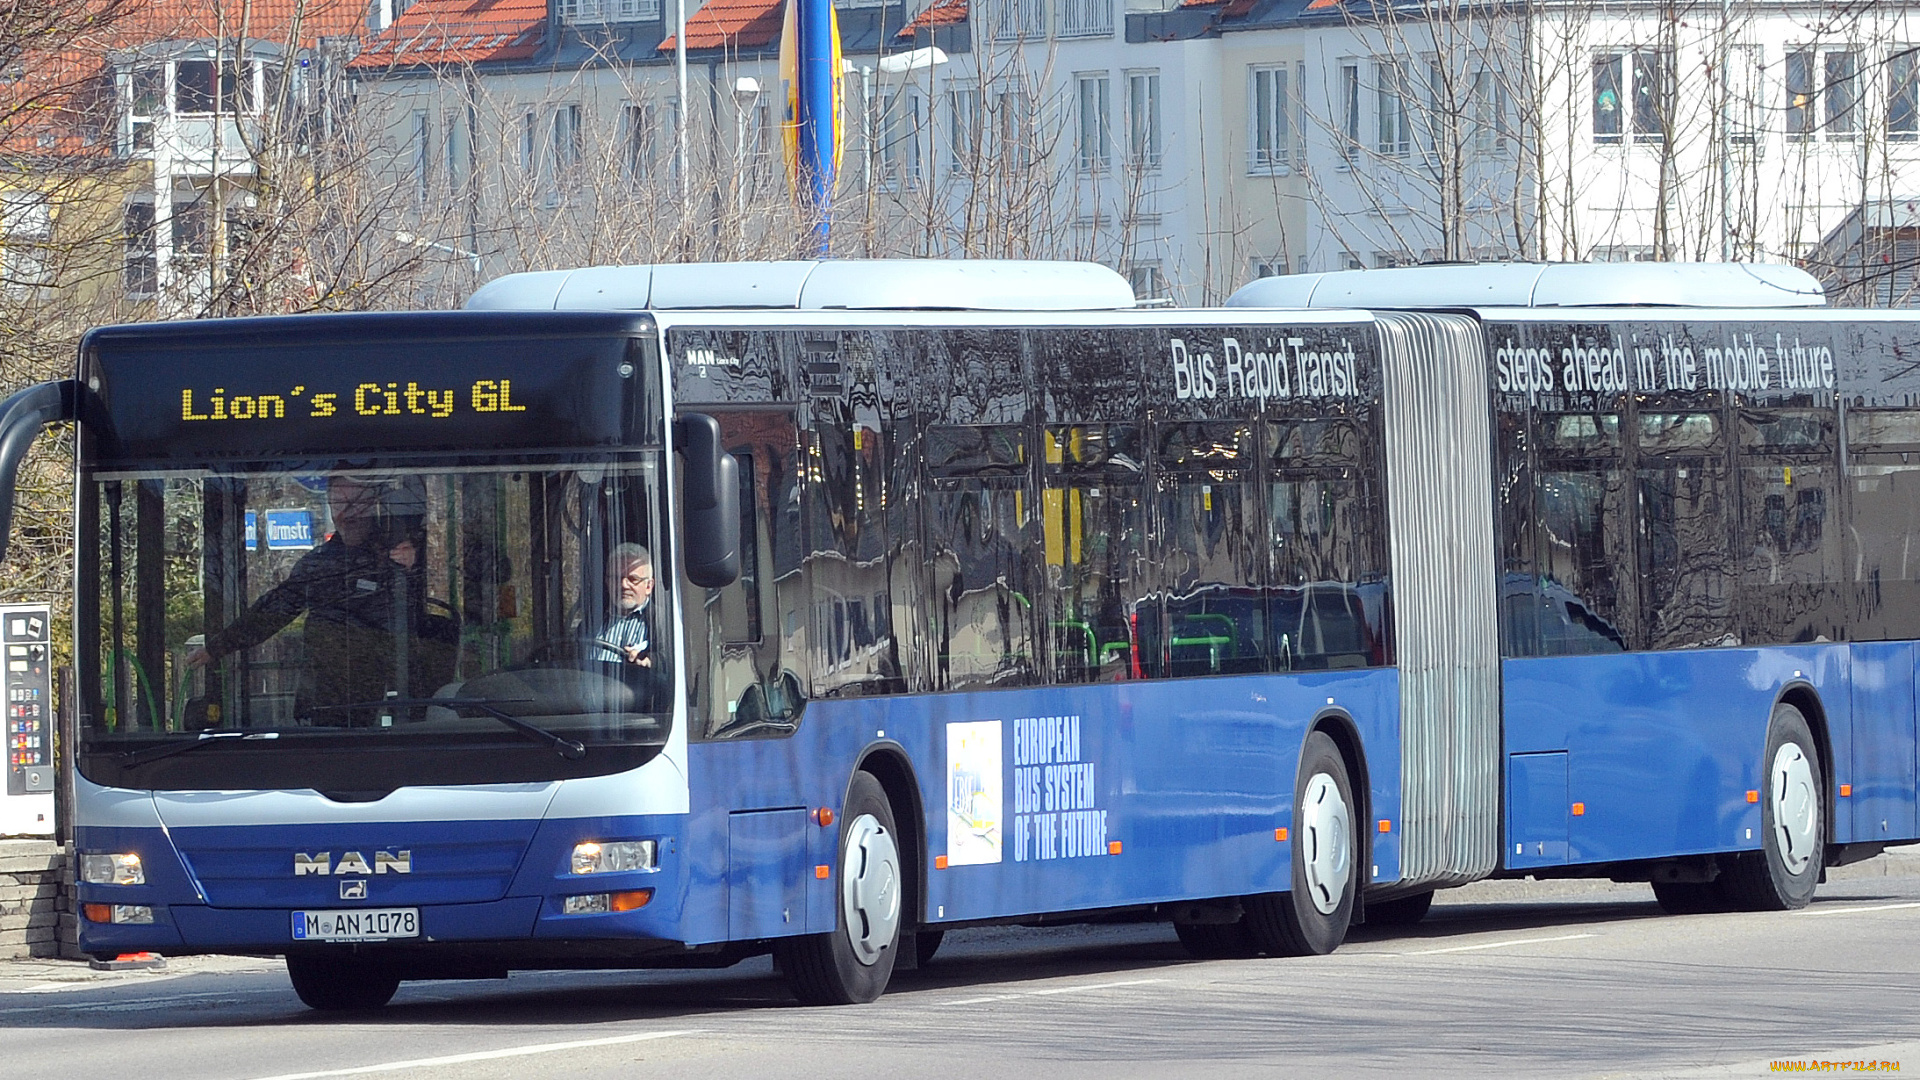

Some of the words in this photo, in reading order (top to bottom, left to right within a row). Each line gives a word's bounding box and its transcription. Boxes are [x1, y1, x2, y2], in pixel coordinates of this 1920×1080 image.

[687, 350, 715, 365] MAN
[1171, 338, 1217, 399] Bus
[1223, 337, 1290, 413] Rapid
[1288, 337, 1359, 398] Transit
[1497, 338, 1553, 406] steps
[1562, 334, 1628, 391] ahead
[1632, 334, 1656, 390] in
[1662, 333, 1697, 391] the
[1705, 333, 1769, 390] mobile
[1775, 332, 1834, 389] future
[355, 382, 453, 417] City
[1013, 715, 1080, 766] EUROPEAN
[1014, 766, 1041, 814] BUS
[1045, 763, 1095, 812] SYSTEM
[1014, 815, 1030, 862] OF
[1034, 813, 1057, 860] THE
[1061, 810, 1107, 858] FUTURE
[294, 850, 411, 875] MAN
[306, 914, 320, 935] M
[335, 913, 361, 935] AN
[365, 912, 415, 934] 1078
